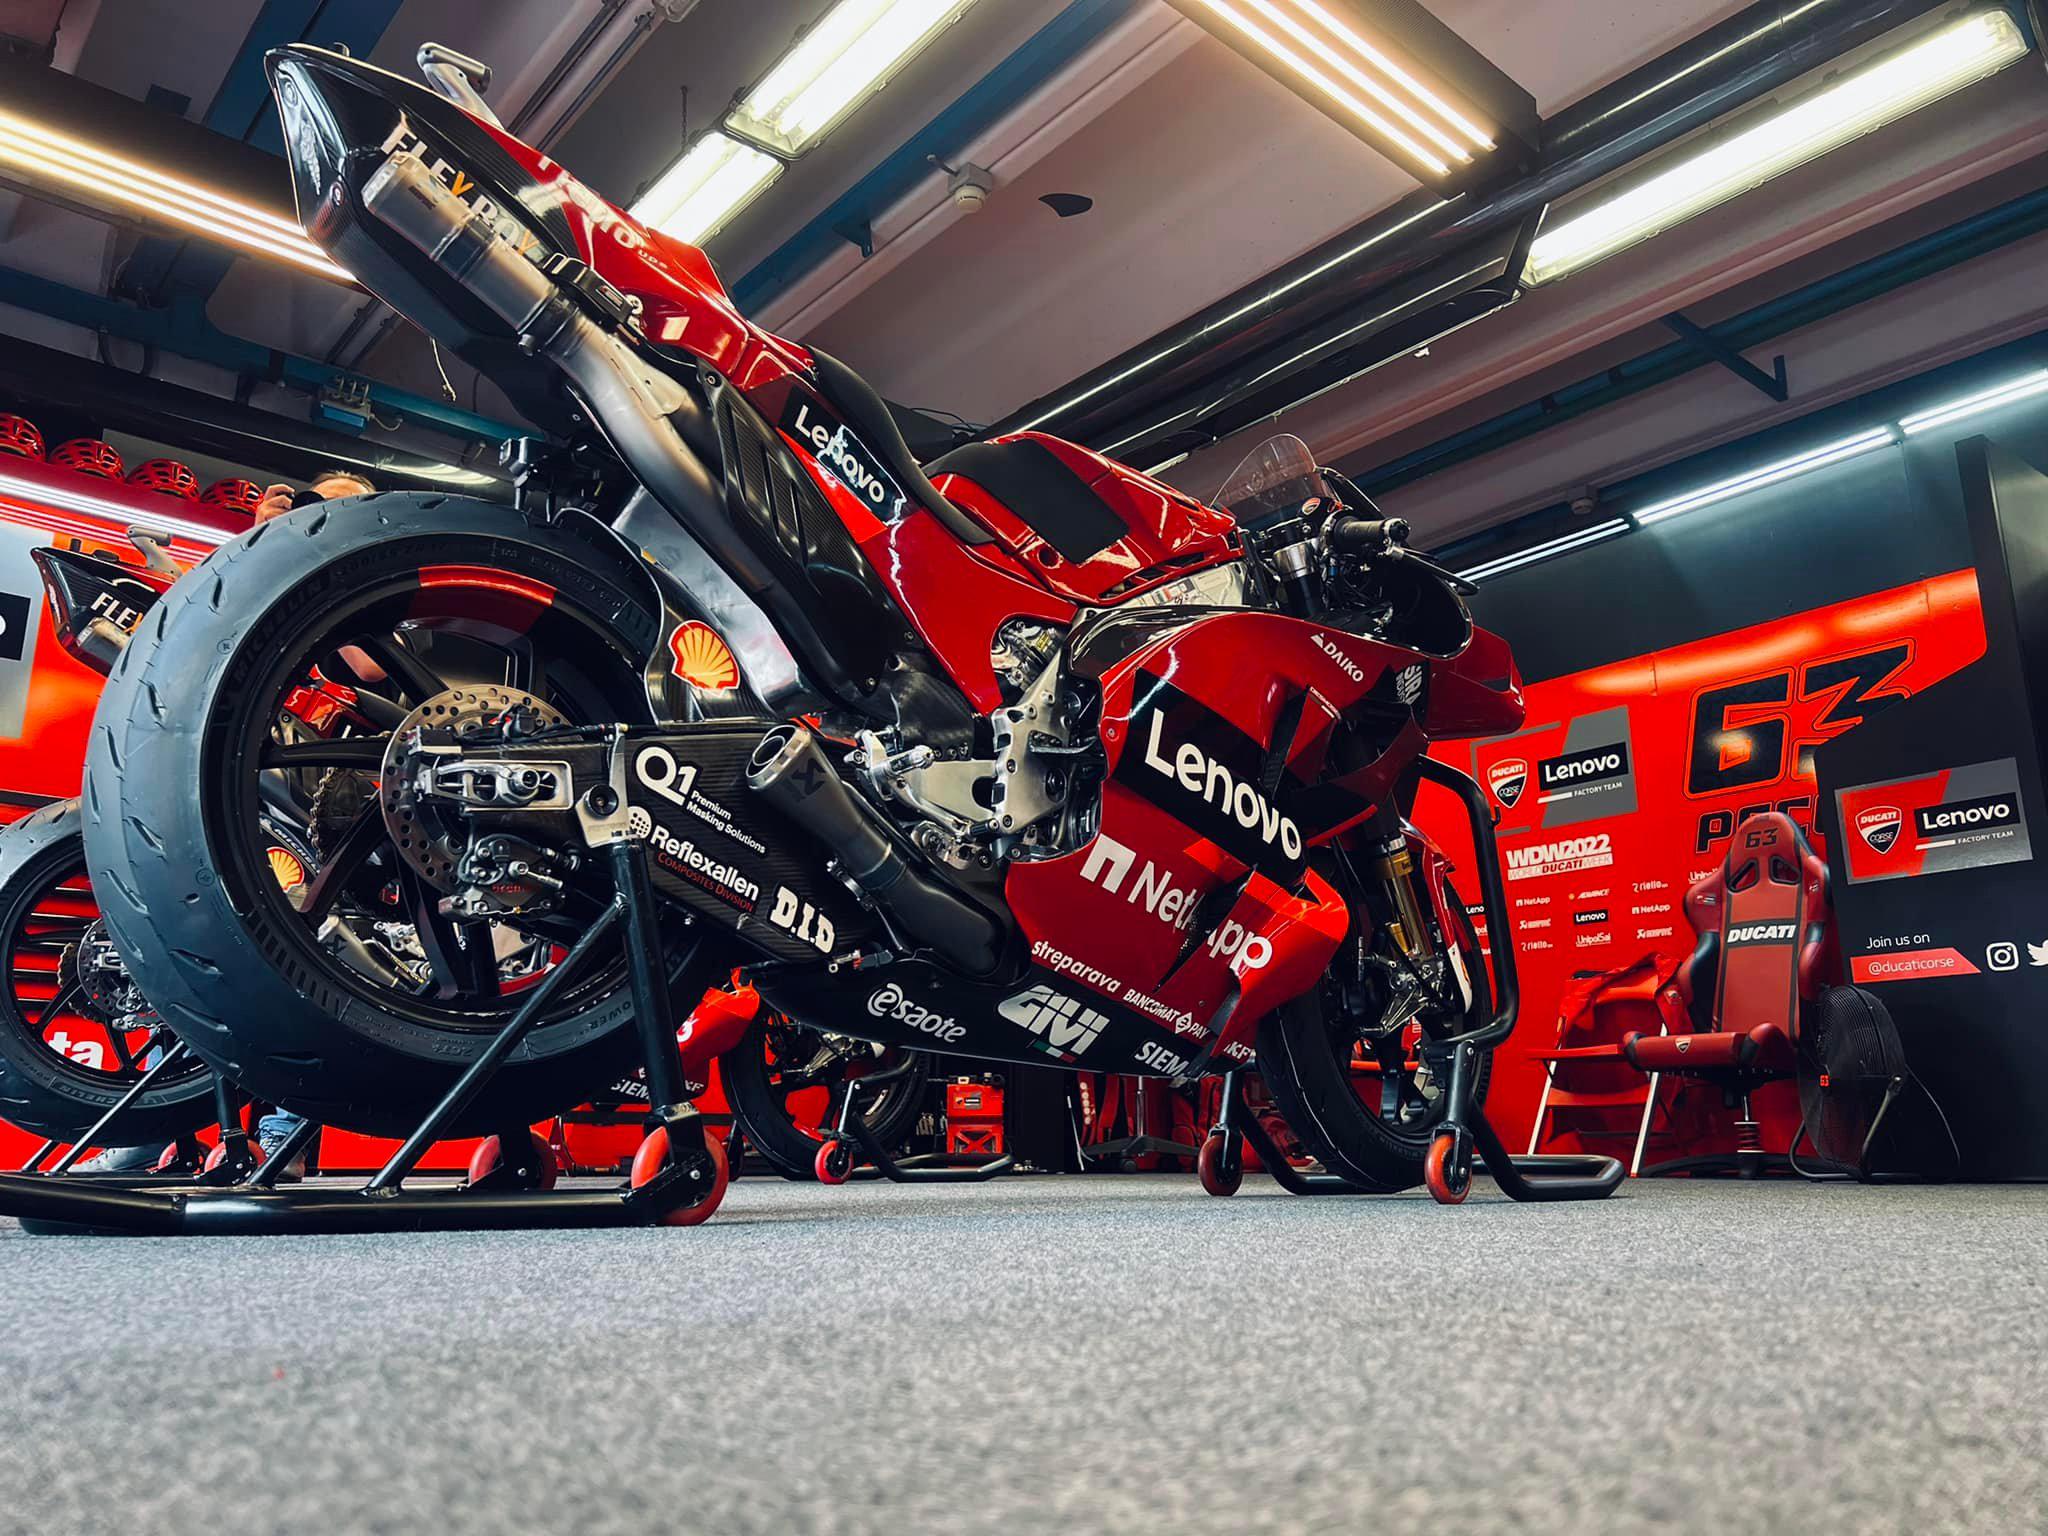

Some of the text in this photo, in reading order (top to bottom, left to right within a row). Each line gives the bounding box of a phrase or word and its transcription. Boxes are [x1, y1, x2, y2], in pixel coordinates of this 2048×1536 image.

[795, 404, 884, 503] Lenovo
[1323, 642, 1364, 682] DAIKO
[636, 746, 697, 805] Q1
[1491, 764, 1523, 778] DUCATI
[1545, 754, 1620, 782] Lenovo
[1145, 707, 1302, 860] Lenovo
[1574, 782, 1623, 797] FACTORY TEAM
[690, 790, 731, 820] Premium
[1861, 811, 1897, 824] DUCATI
[1923, 804, 2010, 830] Lenovo
[686, 801, 766, 853] Masking Solutions
[1745, 827, 1778, 848] 63
[1869, 832, 1894, 843] CORSE
[1958, 830, 2014, 845] FACTORY TEAM
[650, 825, 759, 901] Reflexallen
[1506, 834, 1612, 868] WDW2022
[658, 853, 754, 912] COMPOSITES DIVISION
[1524, 897, 1550, 906] NetApp
[1641, 904, 1671, 914] NetApp
[769, 886, 835, 953] D.I.D
[1576, 913, 1606, 923] Lenovo
[1727, 924, 1797, 943] DUCATI
[1866, 933, 1931, 949] Join us on
[1031, 940, 1122, 993] streparava
[1868, 957, 1955, 976] @ducaticorse
[589, 1001, 632, 1031] OWER
[998, 984, 1111, 1055] GIVI
[1123, 988, 1211, 1040] BANCOMAT PAY
[1223, 1041, 1249, 1059] KF
